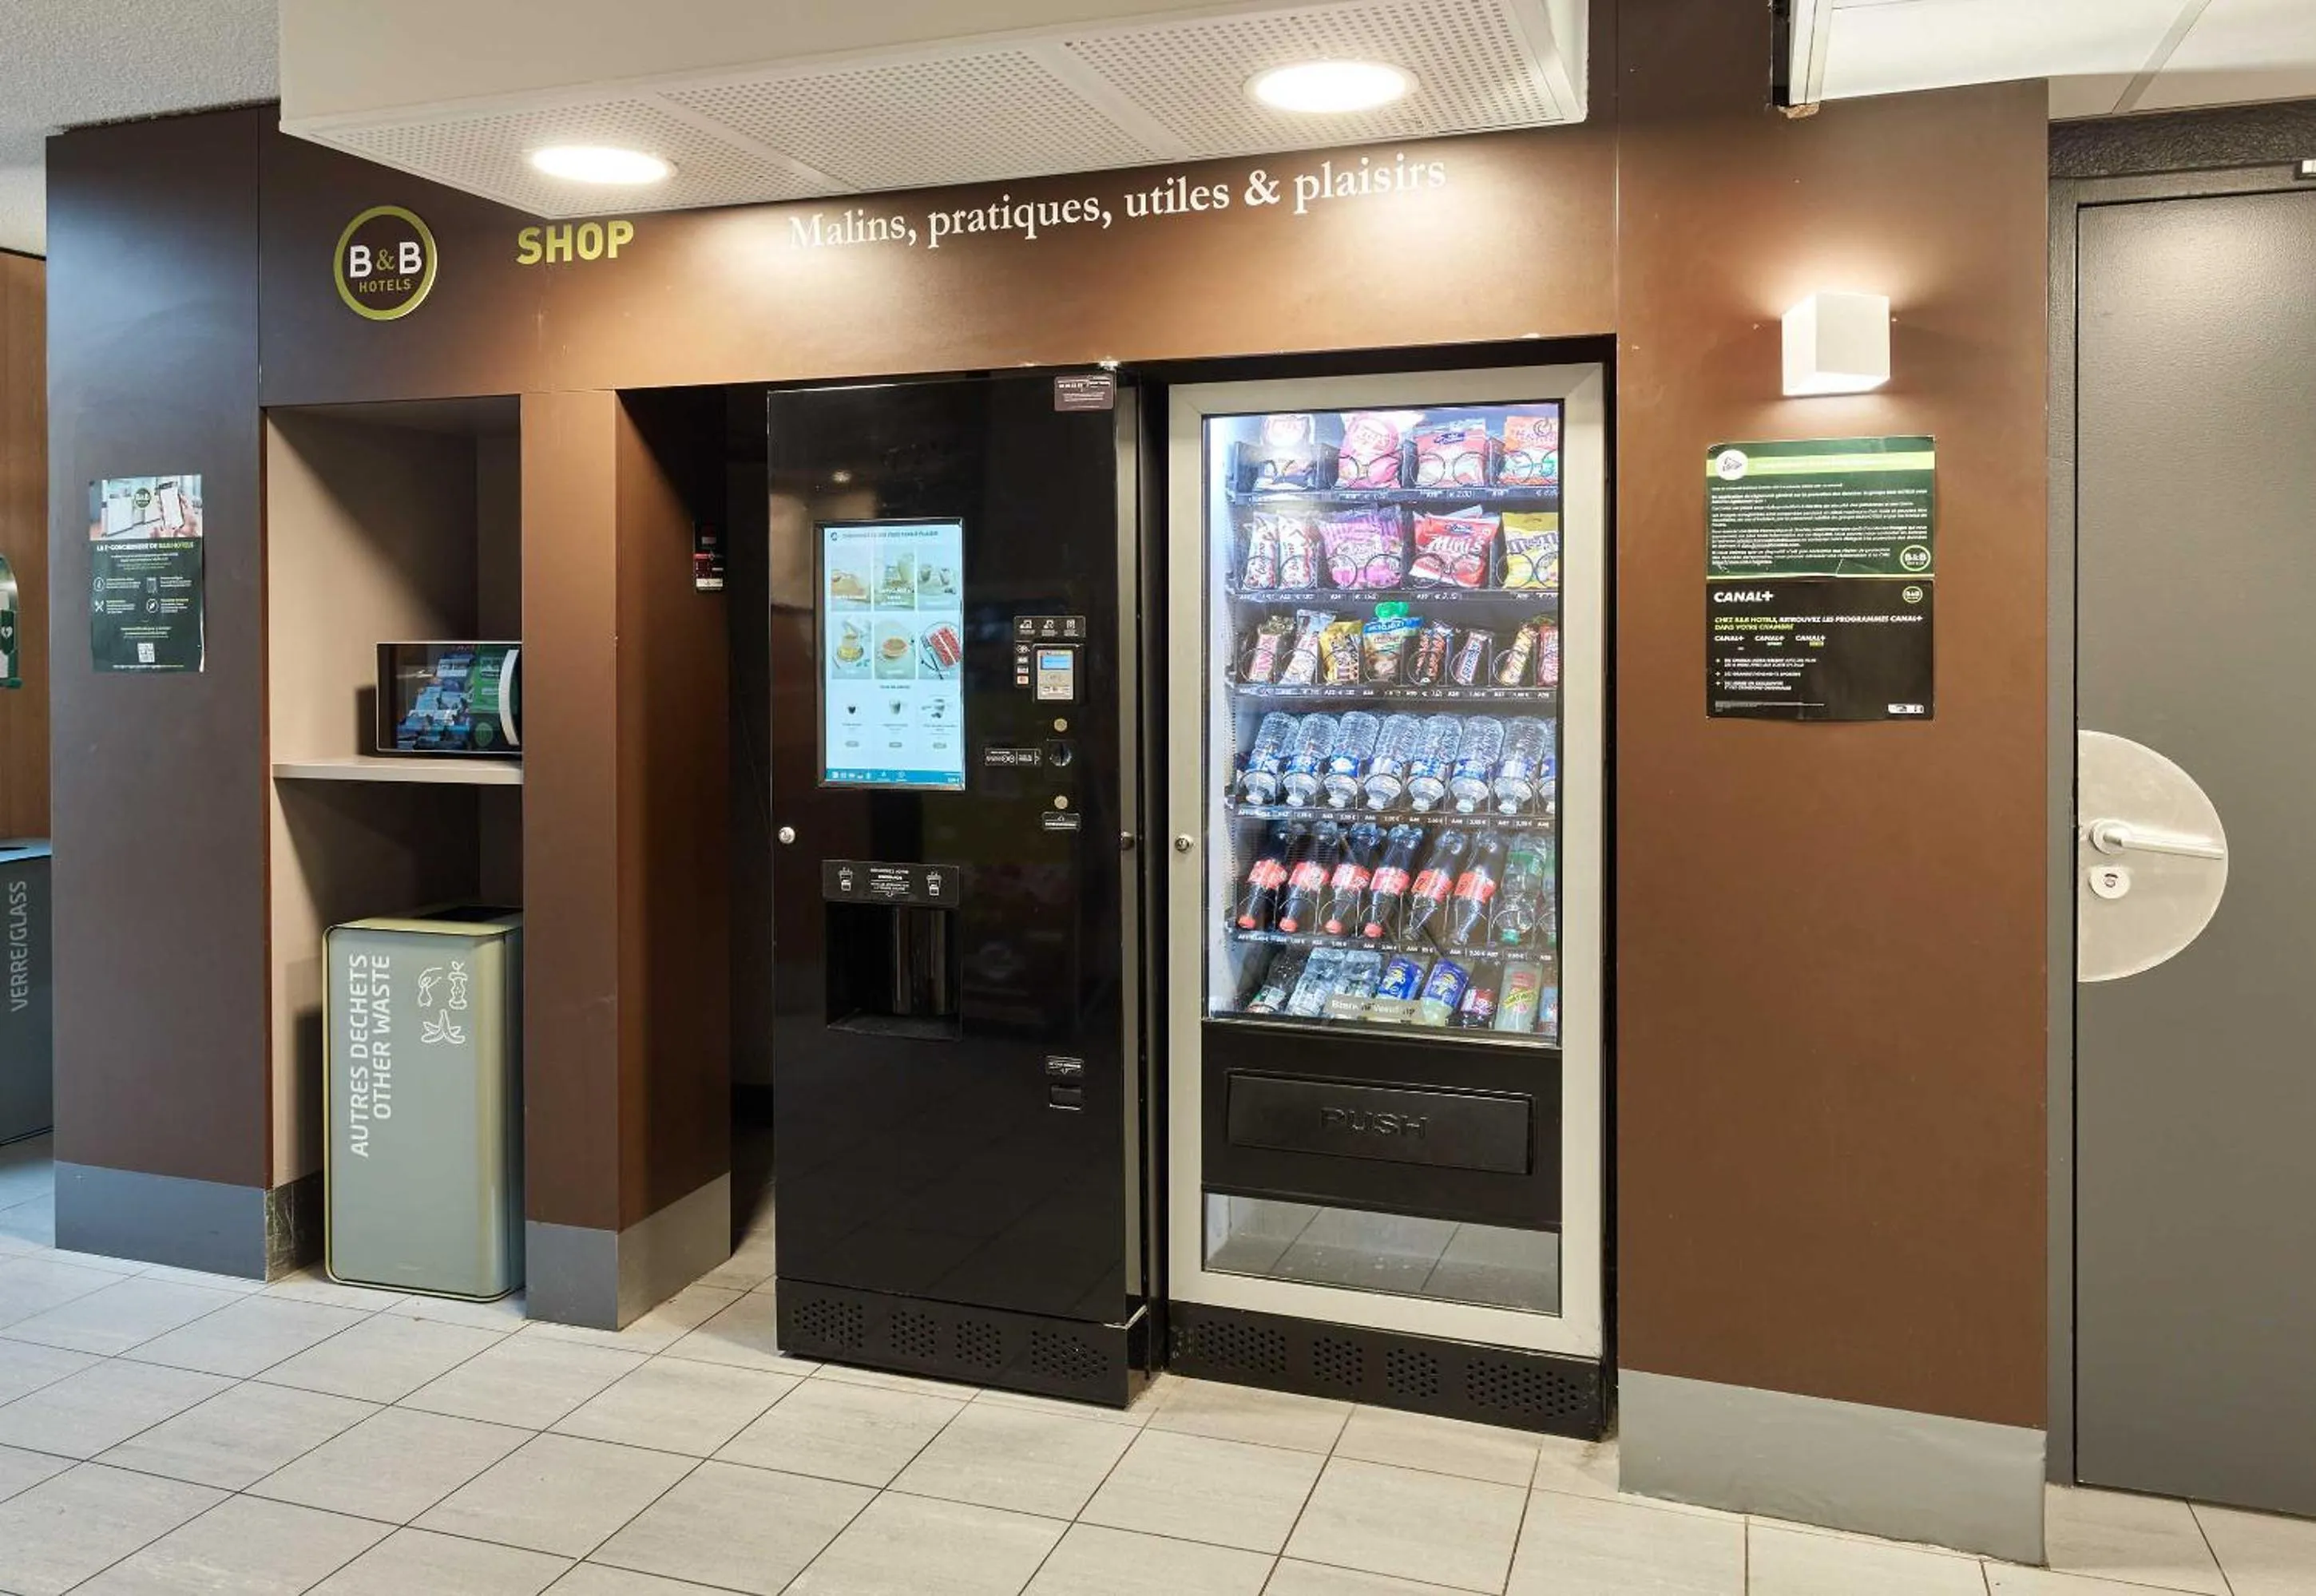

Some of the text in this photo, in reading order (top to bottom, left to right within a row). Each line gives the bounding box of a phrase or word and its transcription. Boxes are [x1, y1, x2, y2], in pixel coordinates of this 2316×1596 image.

[787, 152, 1447, 249] Malins, pratiques, utiles & plaisirs
[515, 220, 635, 266] SHOP
[358, 278, 413, 293] HOTELS
[1713, 590, 1775, 603] CANAL+
[9, 881, 29, 1012] VERRE/GLASS
[349, 953, 369, 1158] AUTRES DECHETS
[371, 955, 391, 1119] OTHER WASTE
[1320, 1107, 1430, 1139] PUSH
